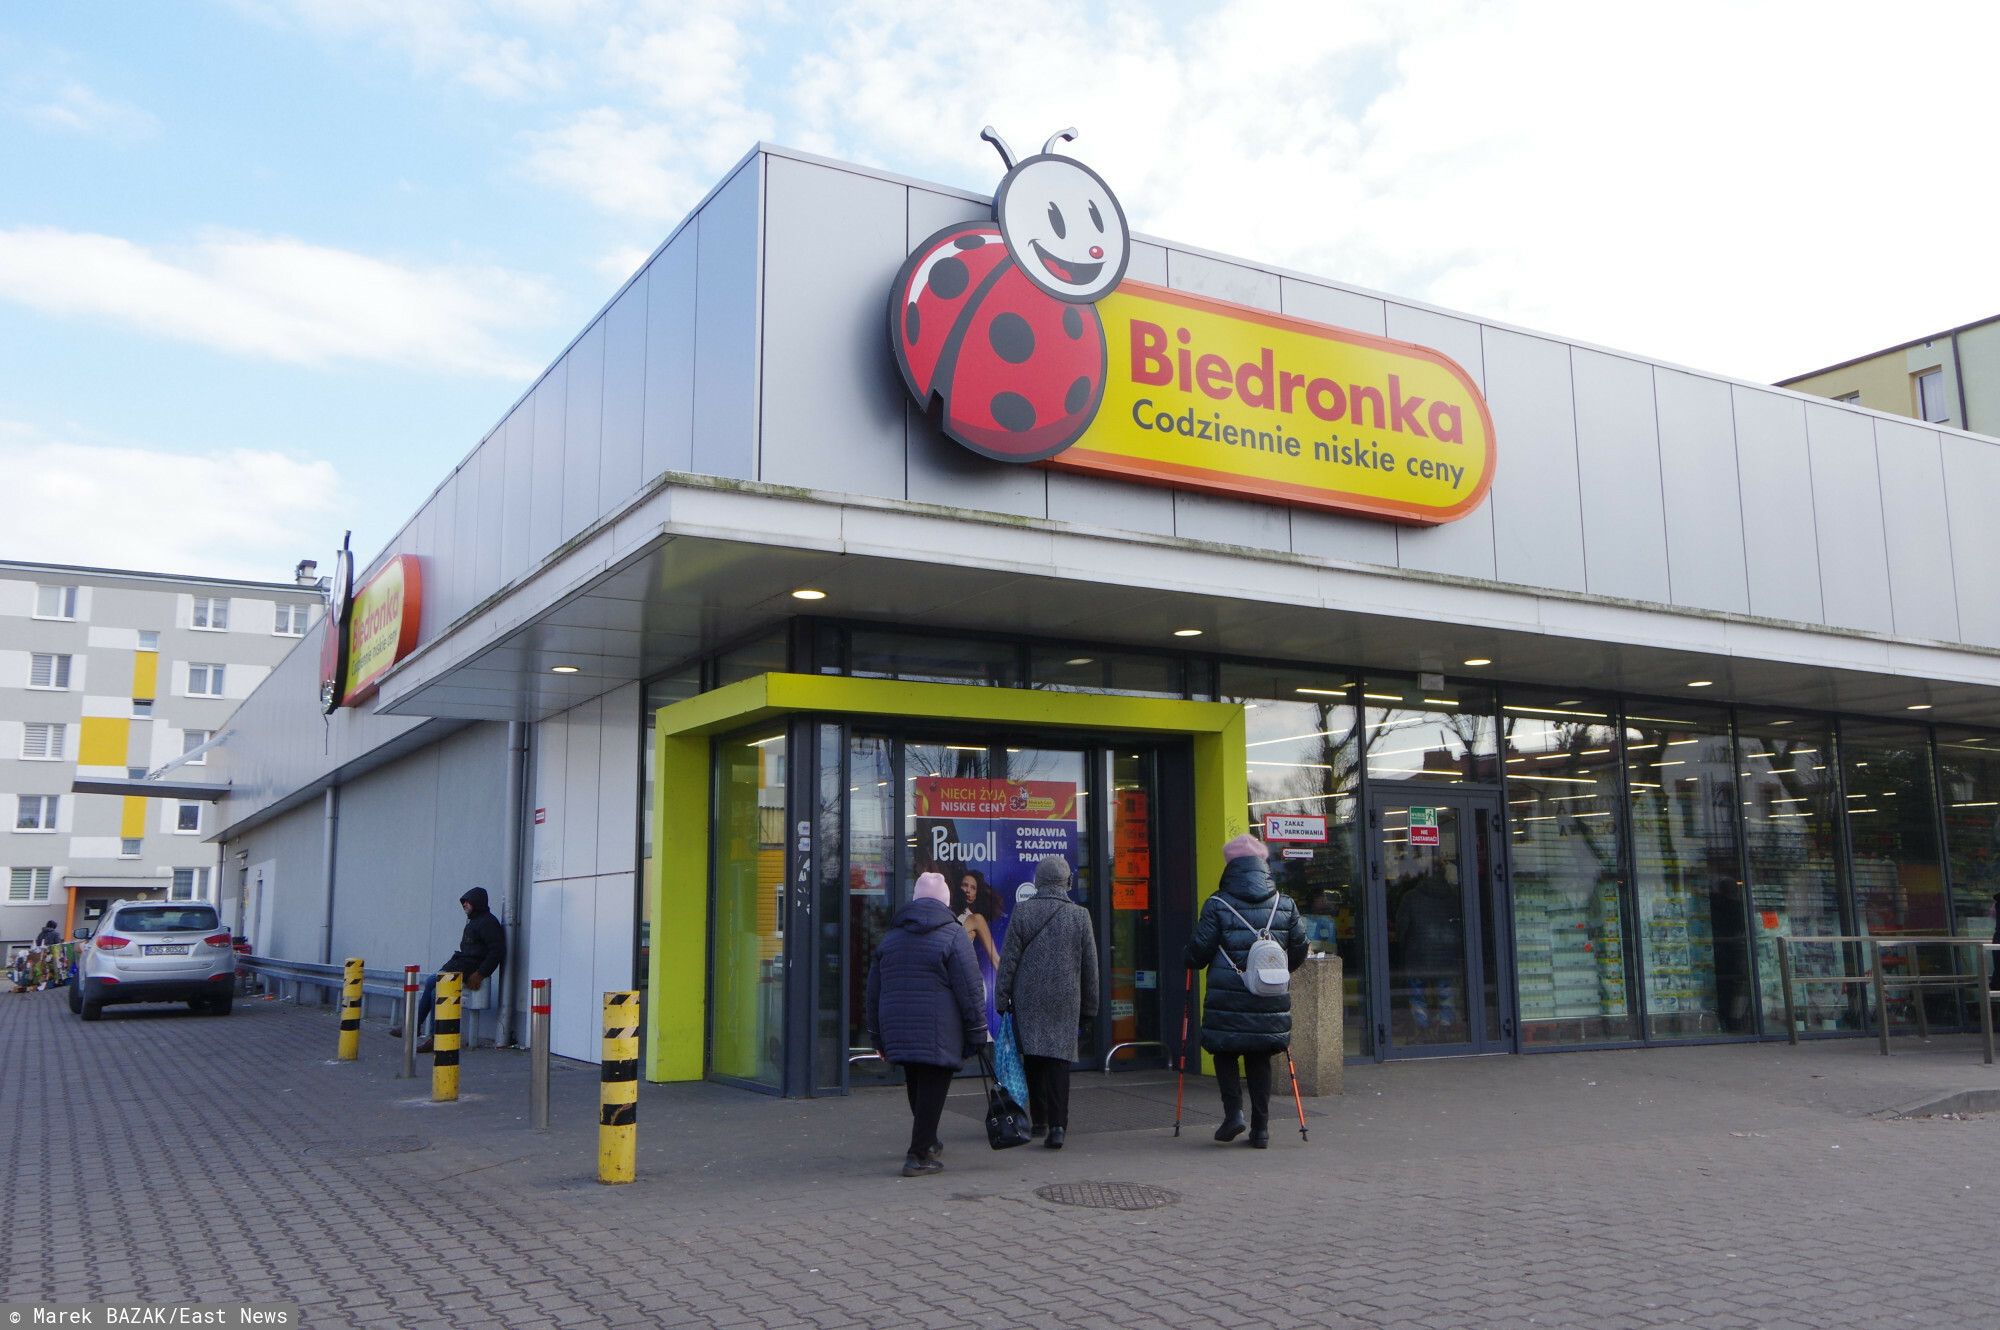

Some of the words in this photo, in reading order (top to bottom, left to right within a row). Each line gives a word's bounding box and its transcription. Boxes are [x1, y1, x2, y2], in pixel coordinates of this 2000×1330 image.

[1129, 319, 1464, 445] Biedronka
[1131, 398, 1301, 457] Codziennie
[1314, 433, 1395, 472] niskie
[1406, 456, 1465, 490] ceny
[940, 787, 976, 800] NIECH
[980, 786, 1007, 802] ŻYJĄ
[940, 801, 976, 812] NISKIE
[979, 802, 1007, 813] CENY
[1016, 827, 1067, 837] ODNAWIA
[931, 825, 997, 862] Perwoll
[1015, 840, 1023, 849] Z
[1024, 838, 1068, 850] KAŻDYM
